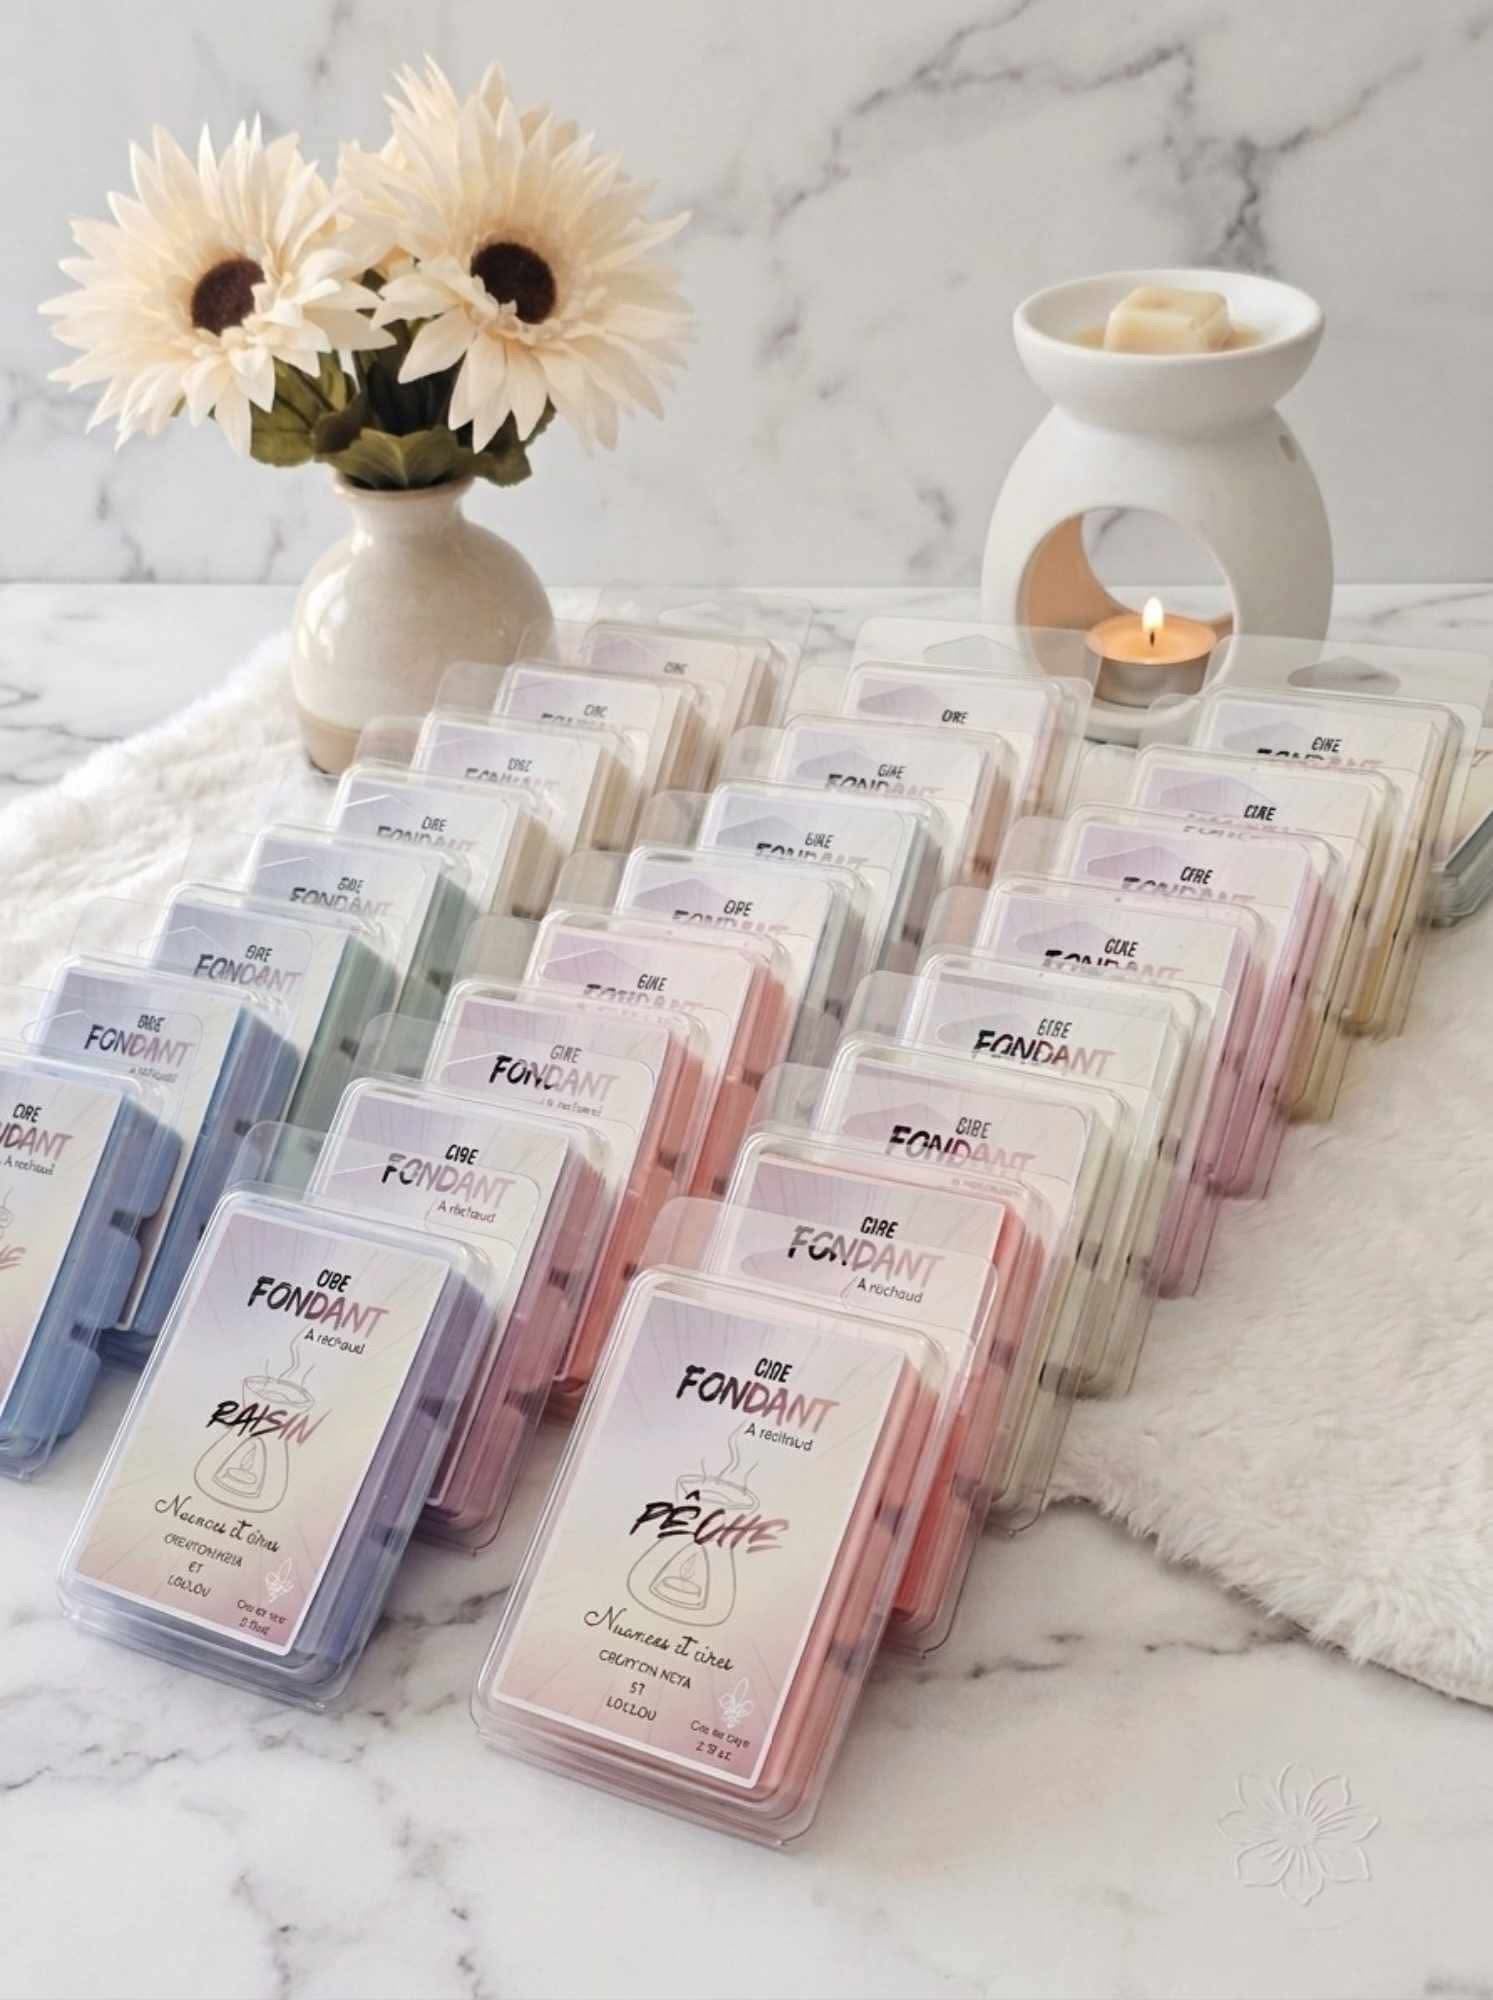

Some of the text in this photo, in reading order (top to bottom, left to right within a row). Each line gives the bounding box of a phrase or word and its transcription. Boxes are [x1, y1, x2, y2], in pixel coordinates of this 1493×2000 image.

[83, 1024, 196, 1067] FONDANT
[488, 1054, 619, 1101] FONDANT
[885, 1124, 1037, 1182] FONDANT
[380, 1152, 516, 1209] FONDANT
[787, 1224, 945, 1289] FONDANT
[247, 1275, 390, 1339] FONDANT
[857, 1278, 867, 1291] A
[304, 1328, 315, 1341] A
[206, 1399, 332, 1445] RAISIN
[676, 1364, 841, 1434] FONDANT
[744, 1422, 756, 1437] A
[629, 1489, 790, 1554] PÊCHE
